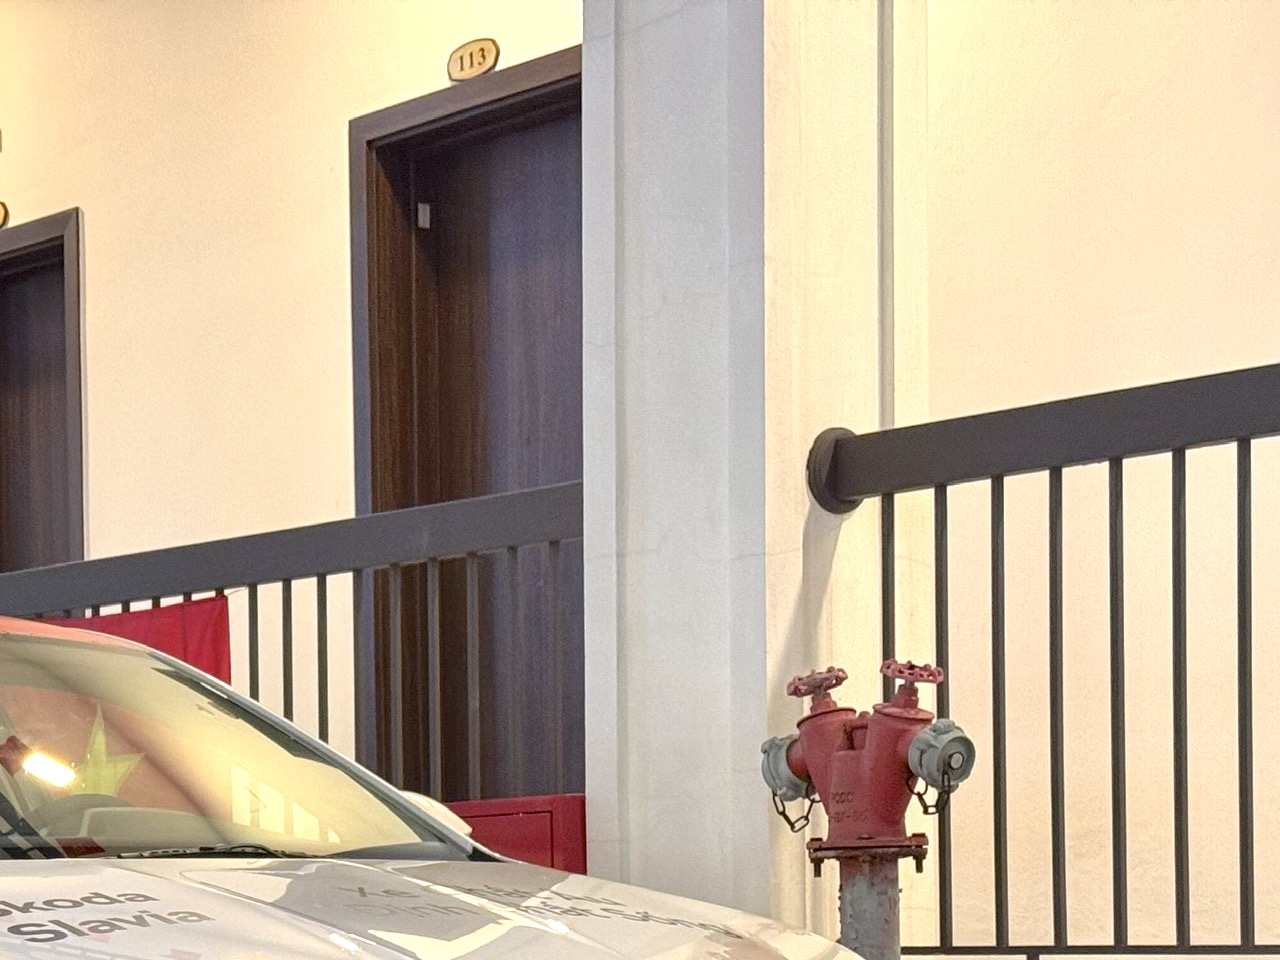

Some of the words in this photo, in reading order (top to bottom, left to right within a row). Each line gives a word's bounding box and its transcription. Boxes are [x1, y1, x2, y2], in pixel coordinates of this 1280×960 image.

[459, 47, 486, 71] 113
[337, 885, 419, 898] Xe
[7, 909, 214, 942] Slavia
